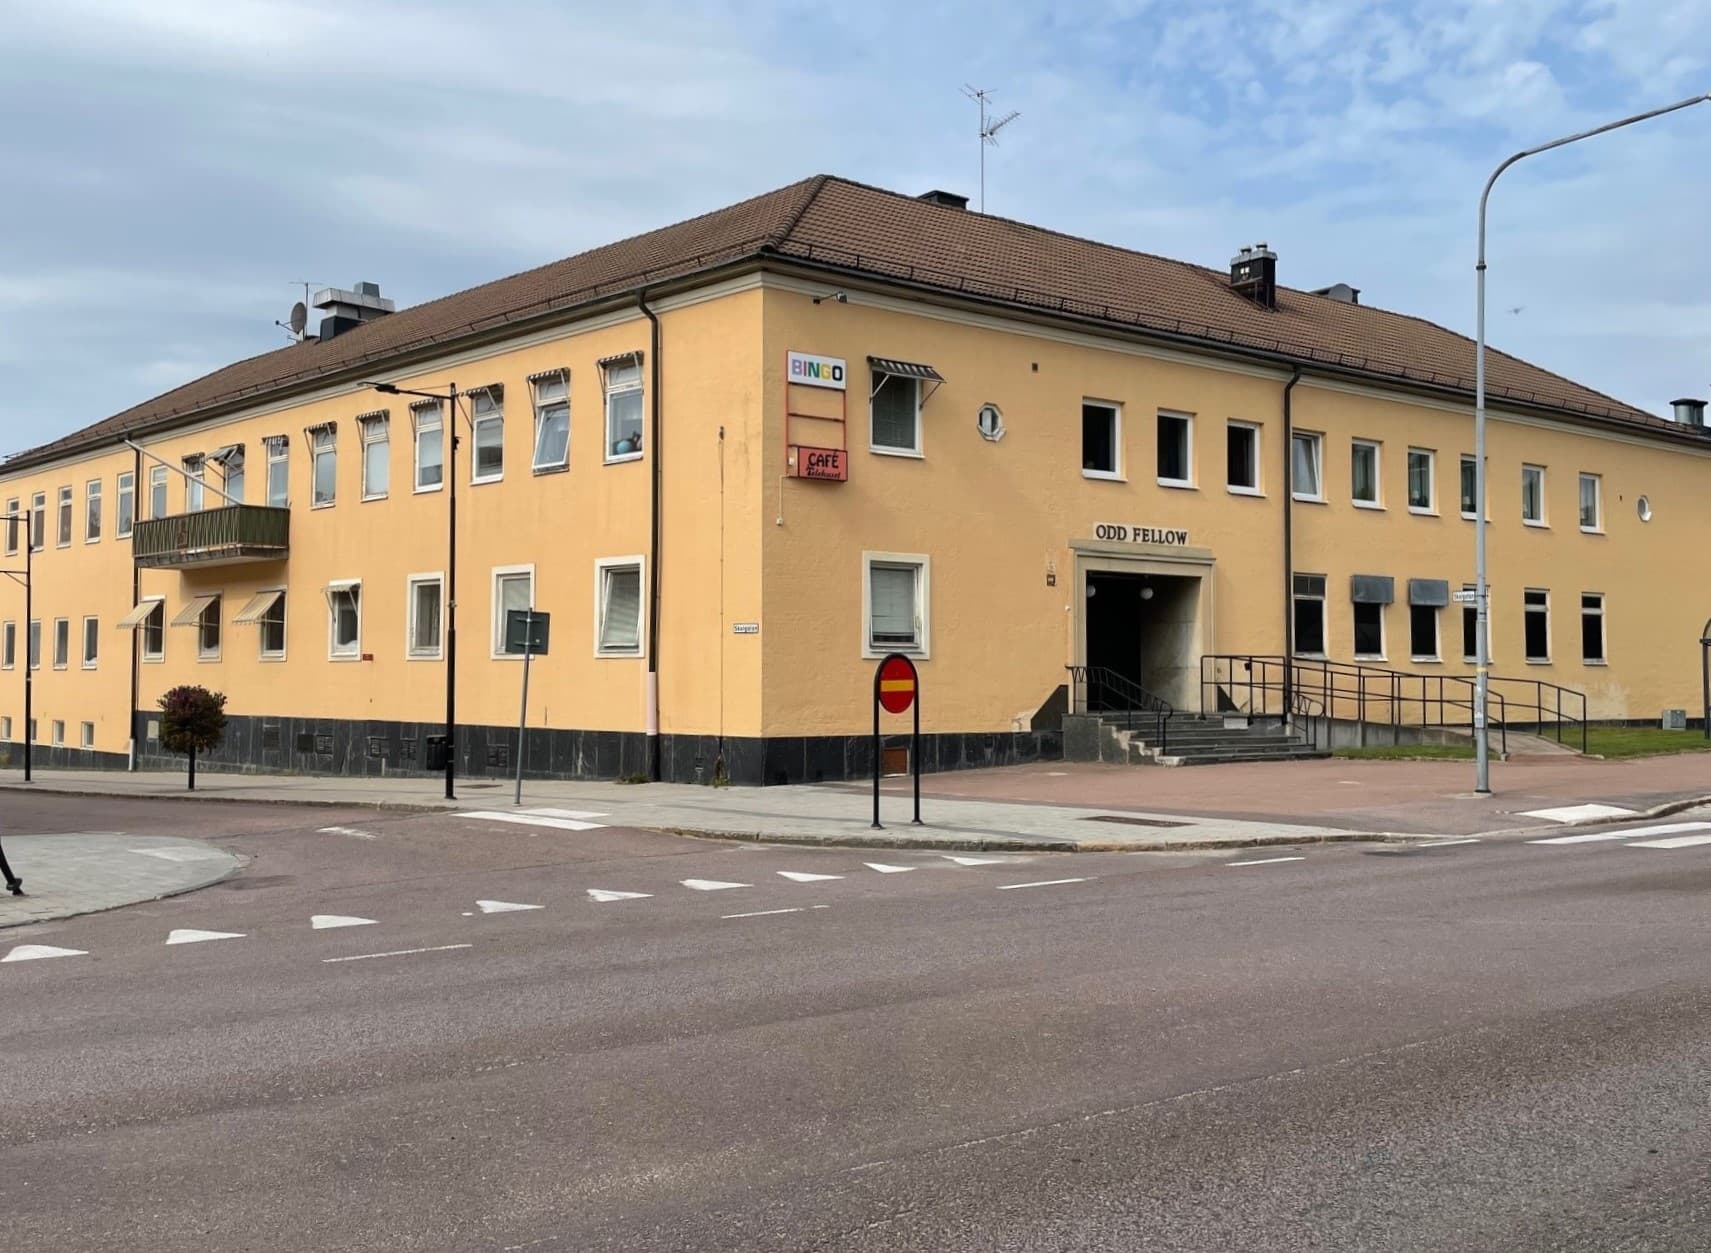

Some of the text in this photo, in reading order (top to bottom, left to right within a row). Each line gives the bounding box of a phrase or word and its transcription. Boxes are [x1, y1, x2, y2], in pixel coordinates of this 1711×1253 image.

[791, 358, 843, 382] BINGO
[808, 450, 839, 469] CAFÉ
[1096, 524, 1188, 545] ODD FELLOW
